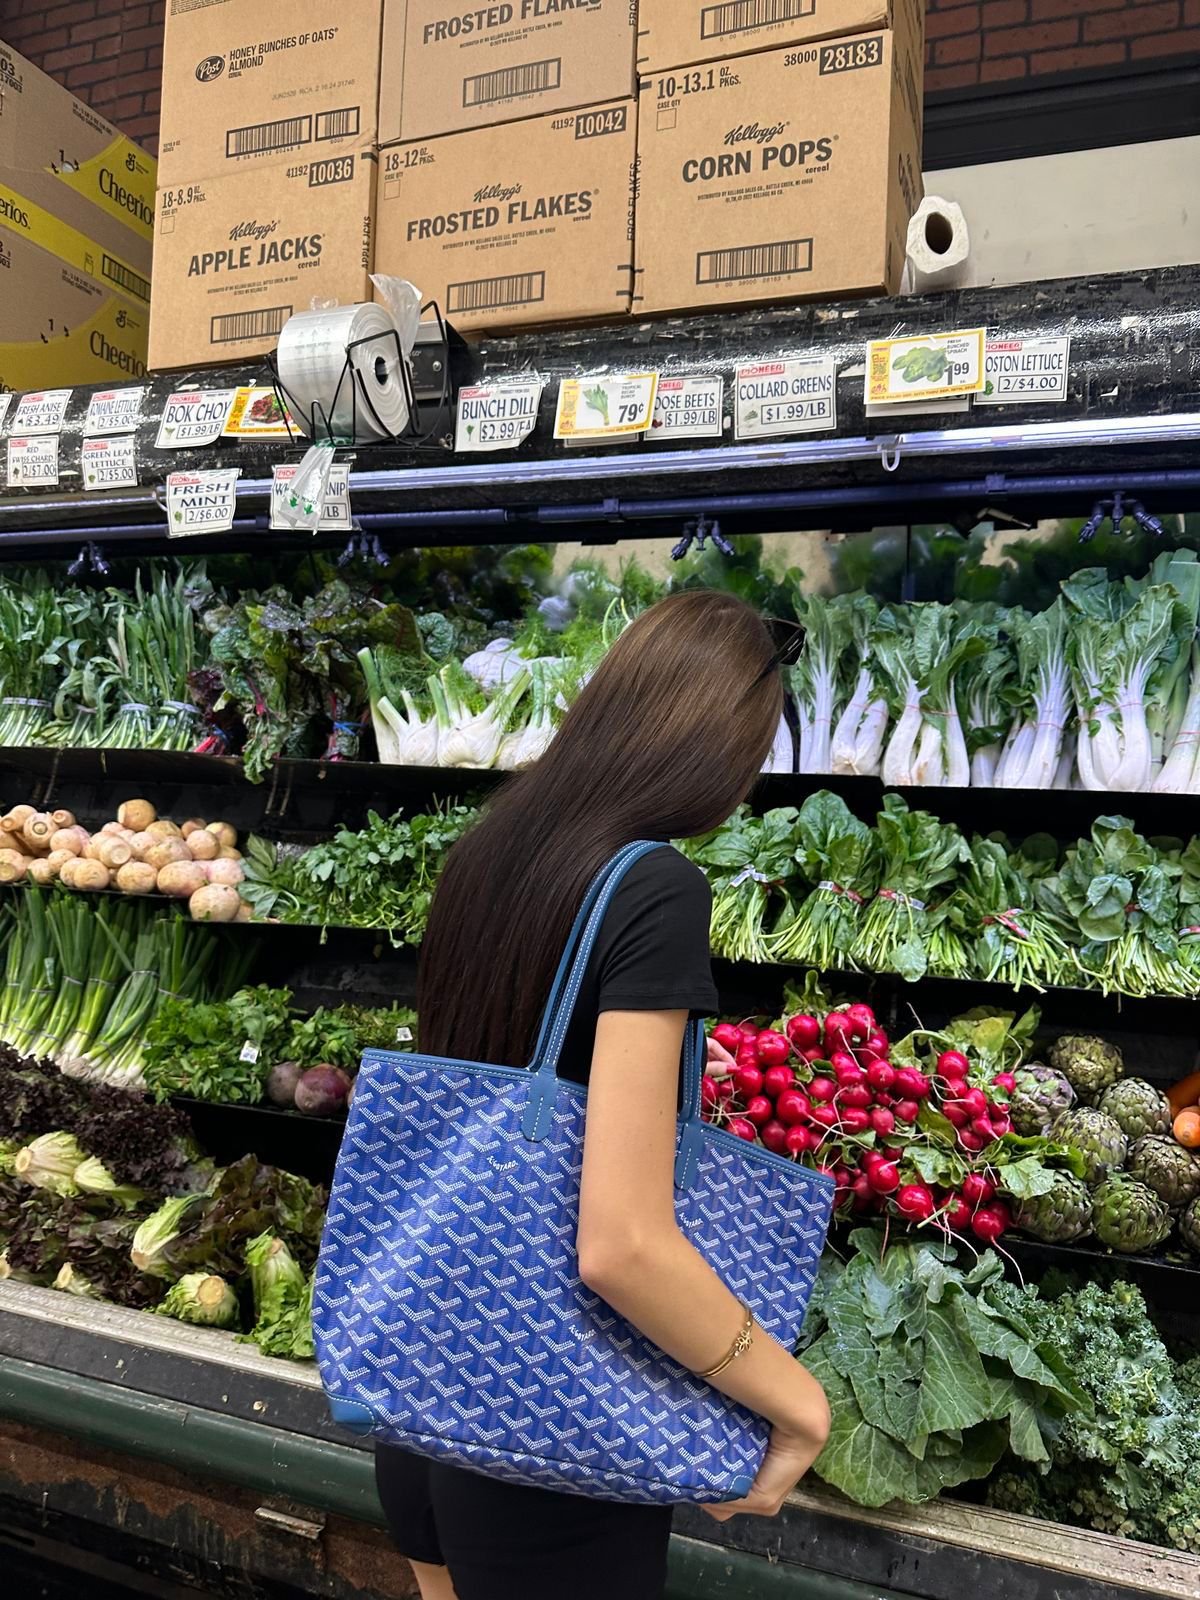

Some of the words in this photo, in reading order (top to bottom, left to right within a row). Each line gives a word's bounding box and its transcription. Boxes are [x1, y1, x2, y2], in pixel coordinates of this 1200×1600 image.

[424, 4, 513, 44] FROSTED
[521, 0, 601, 20] FLAK
[229, 44, 257, 61] HONEY
[258, 36, 297, 54] BUNCHES
[298, 34, 310, 46] OF
[312, 28, 336, 44] OATS
[228, 55, 264, 72] ALMOND
[783, 50, 818, 67] 38000
[823, 40, 880, 72] 28183
[200, 59, 220, 80] Post
[720, 66, 731, 77] OZ.
[657, 70, 716, 99] 10-13.1
[719, 75, 742, 88] PKGS.
[657, 101, 670, 109] CASE
[670, 99, 681, 107] QTY
[551, 117, 574, 130] 41192
[578, 110, 623, 136] 10042
[724, 122, 785, 146] Kellogg's
[384, 150, 418, 172] 18-12
[682, 150, 752, 183] CORN
[762, 137, 832, 170] POPS
[805, 162, 830, 174] cereal
[286, 164, 308, 178] 41192
[310, 158, 352, 185] 10036
[162, 187, 194, 209] 18-8.9
[472, 182, 522, 203] Kellogg's
[406, 206, 499, 242] FROSTED
[508, 190, 592, 224] FLAKES
[230, 220, 277, 240] Kellogg's
[188, 246, 252, 277] APPLE
[257, 234, 322, 266] JACKS
[298, 258, 320, 270] cereal
[741, 364, 782, 375] PIONEER
[986, 356, 1018, 372] OSTON
[1022, 353, 1064, 371] LETTUCE
[739, 379, 788, 400] COLLARD
[792, 375, 832, 394] GREENS
[1003, 376, 1058, 390] 2/$4.00
[18, 403, 41, 416] FRESH
[462, 400, 508, 420] BUNCH
[509, 396, 534, 414] DILL
[655, 396, 680, 410] OOSE
[684, 393, 715, 408] BEETS
[27, 414, 59, 426] $3.49
[166, 405, 195, 423] BOK
[196, 400, 232, 422] CHOY
[619, 403, 644, 423] 79¢
[667, 410, 716, 426] $1.99/LB
[766, 402, 826, 421] $1.99/LB
[181, 424, 220, 436] $1.99/LB
[84, 450, 110, 459] GREEN
[24, 465, 55, 476] 2/$7.00
[91, 460, 125, 468] LETTUCE
[100, 469, 133, 480] 2/$5.00
[173, 483, 230, 495] FRESH
[326, 482, 345, 496] NIP
[180, 495, 230, 508] MINT
[188, 508, 228, 521] 2/$6.00
